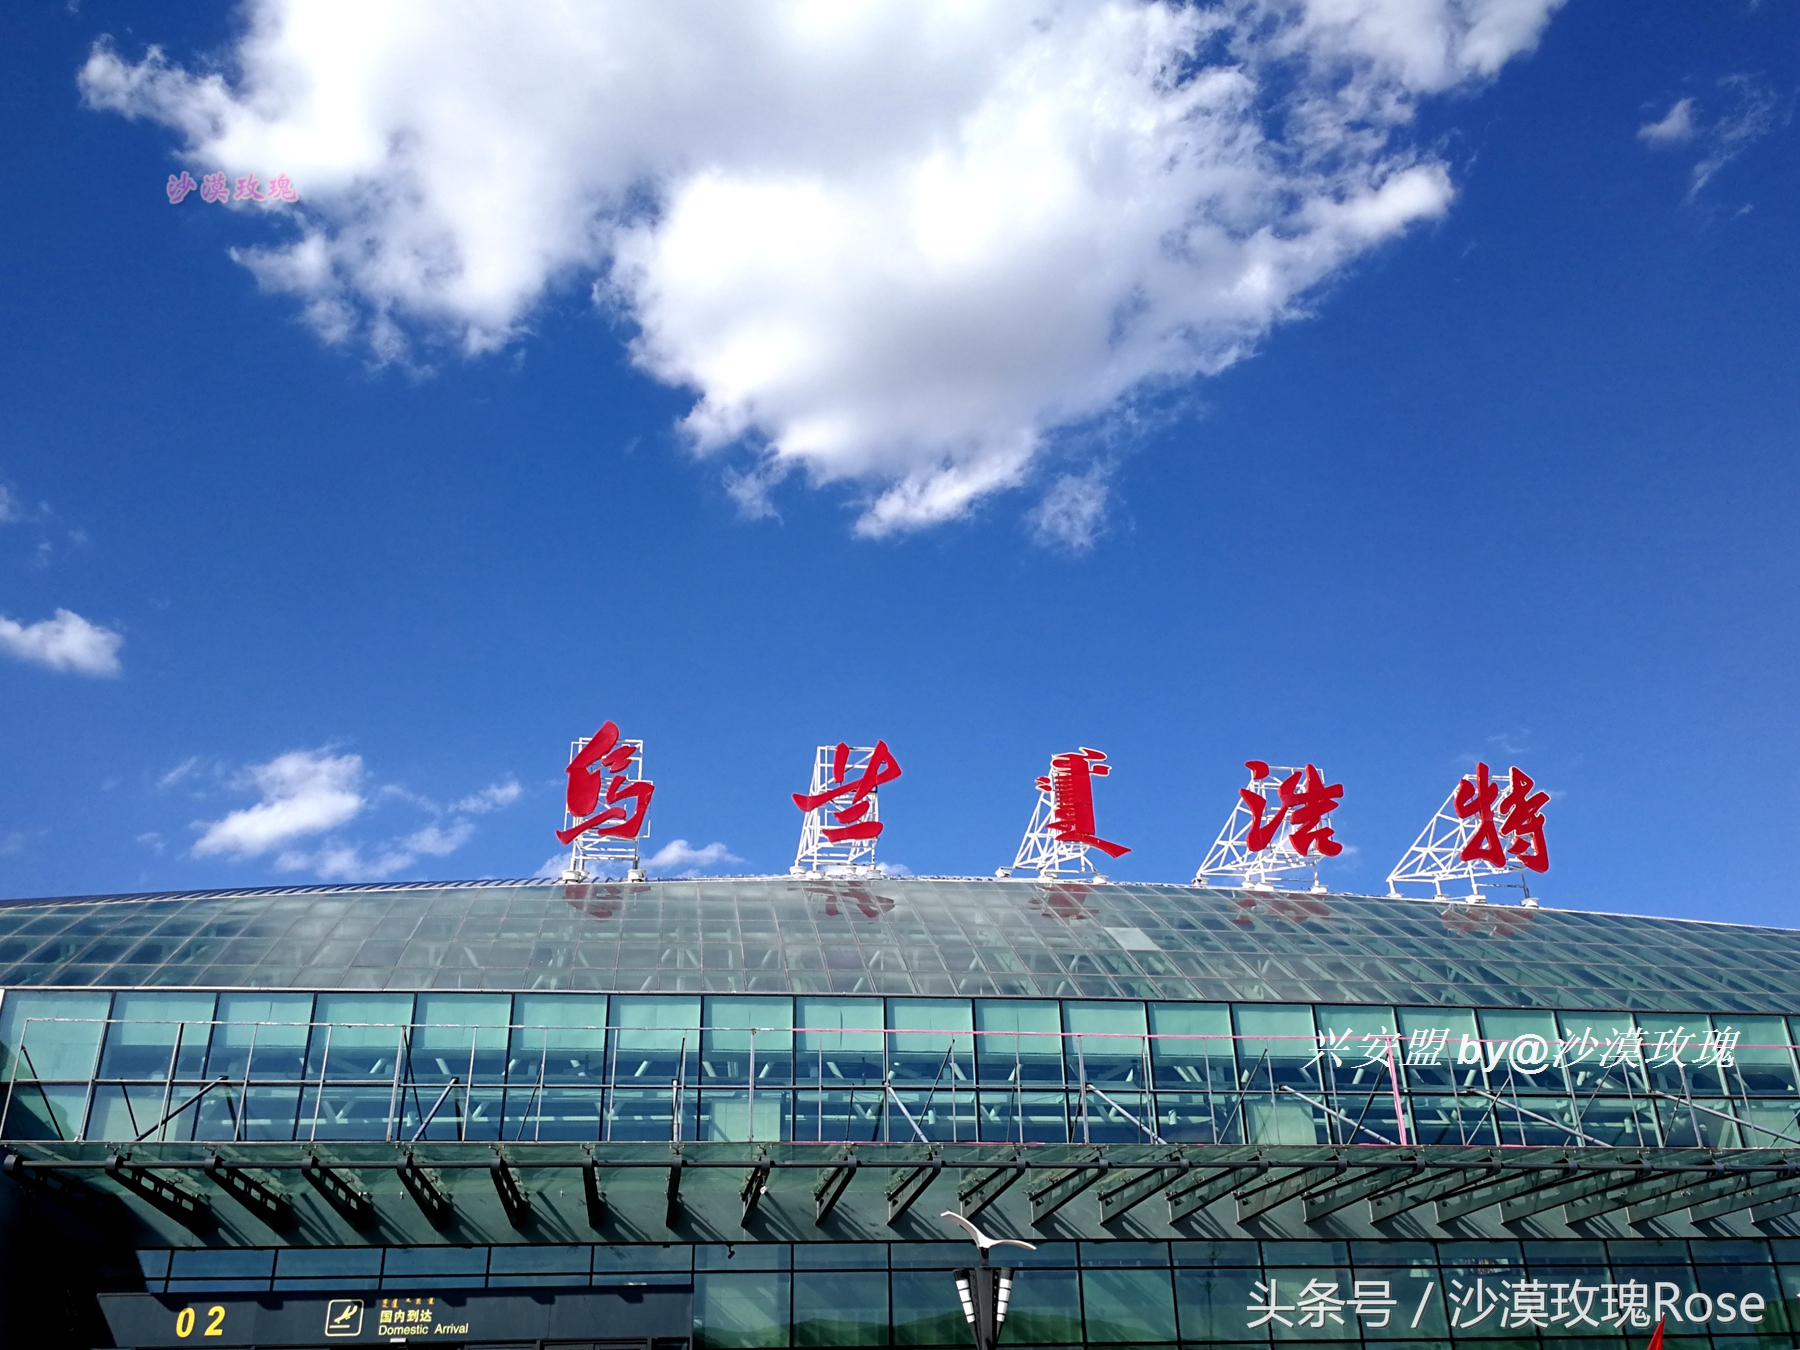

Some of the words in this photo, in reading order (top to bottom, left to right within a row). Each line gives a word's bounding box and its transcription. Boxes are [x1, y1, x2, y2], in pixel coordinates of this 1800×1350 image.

[176, 1305, 226, 1338] 02
[380, 1309, 432, 1324] 国内到达
[378, 1324, 429, 1336] Domestic
[434, 1323, 469, 1335] Arrival
